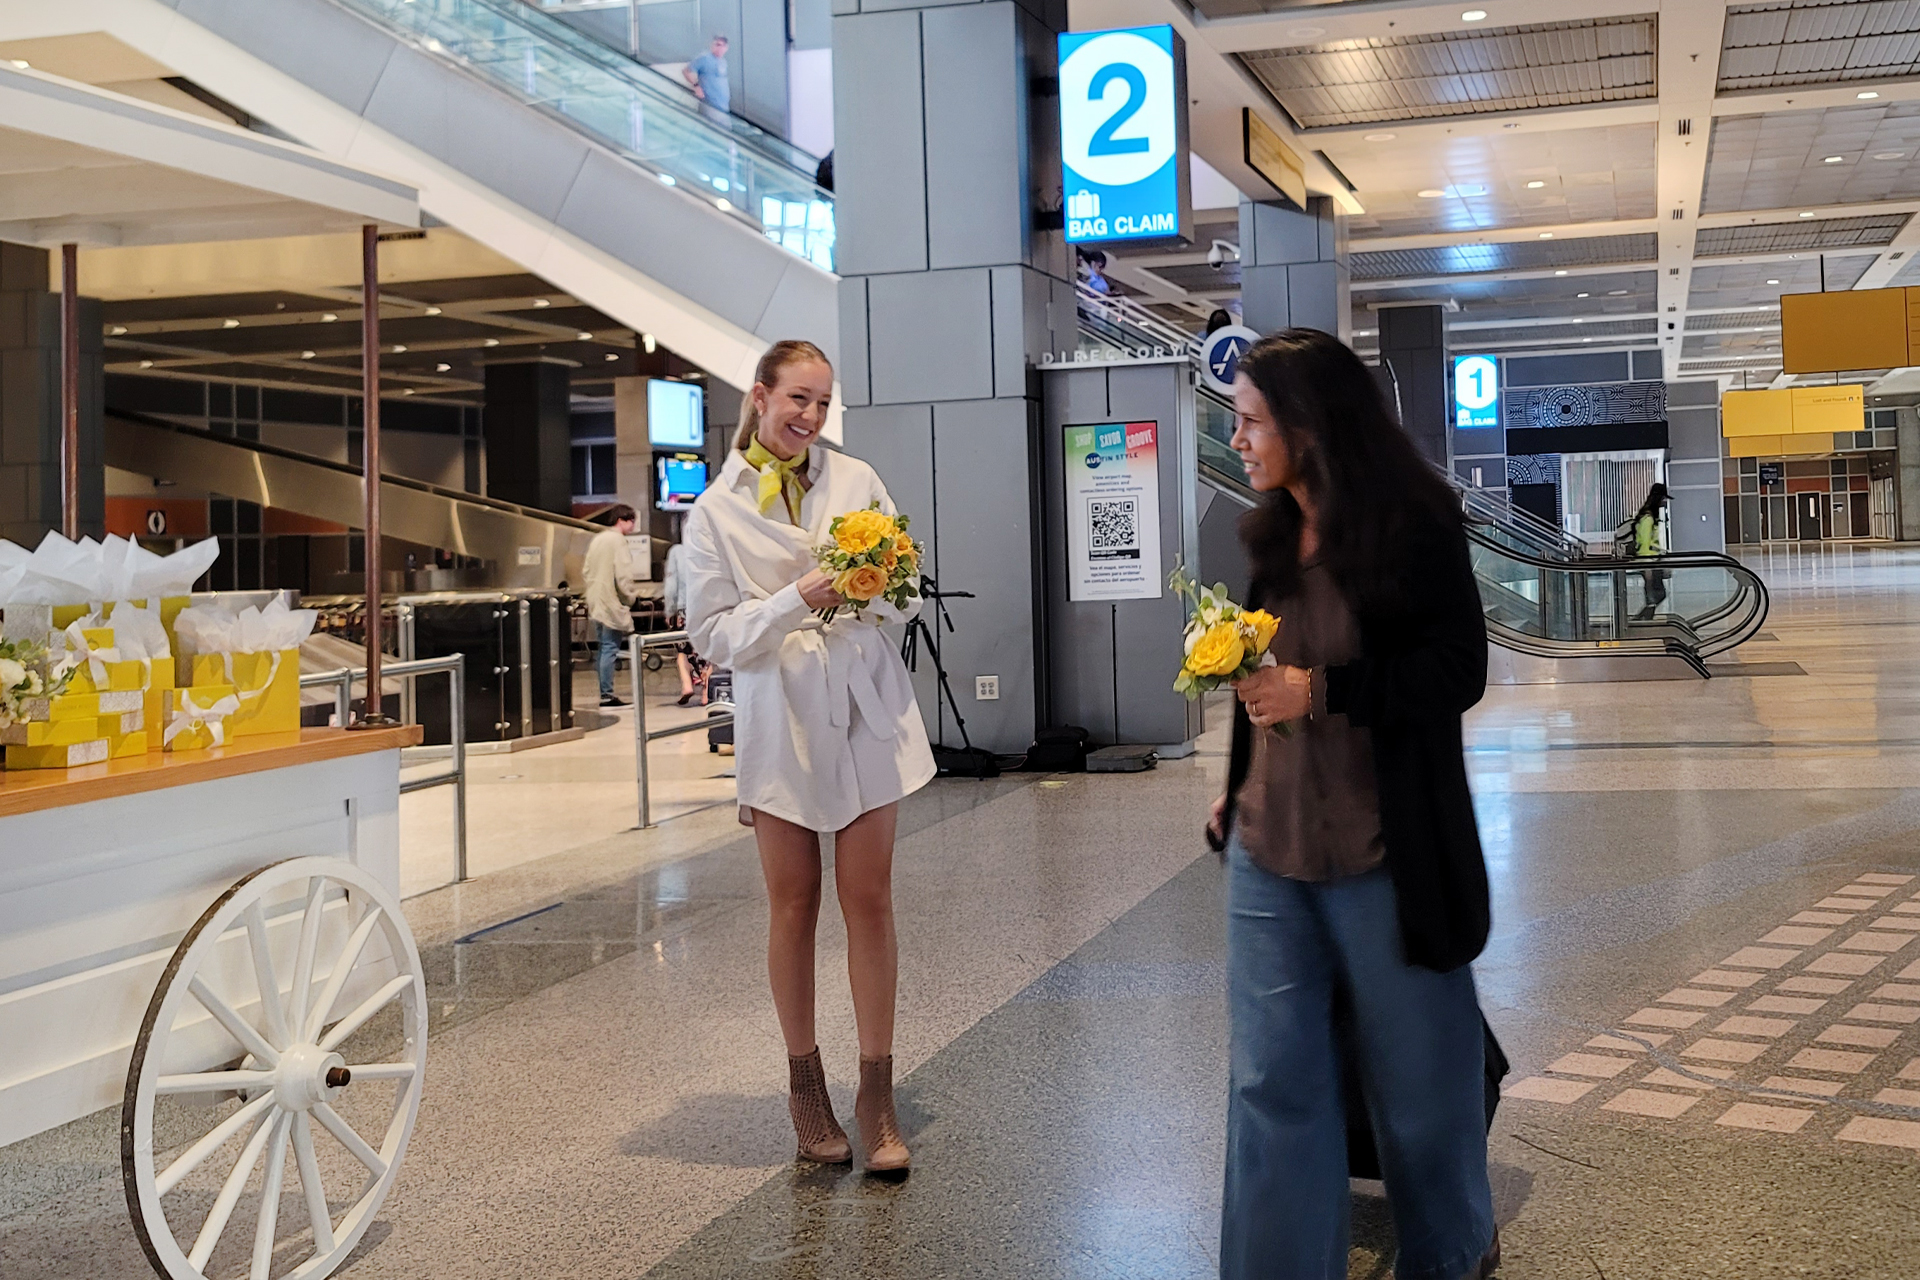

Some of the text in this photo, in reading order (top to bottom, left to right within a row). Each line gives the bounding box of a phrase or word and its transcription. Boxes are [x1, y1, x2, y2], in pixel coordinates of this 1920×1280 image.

[1087, 62, 1149, 157] 2
[1069, 212, 1175, 238] BAG CLAIM
[1042, 345, 1180, 364] DIRECTORY
[1469, 368, 1482, 398] 1
[1099, 430, 1122, 448] SAVOR
[1126, 428, 1154, 449] GROOVE
[1086, 452, 1139, 465] AUSTIN STYLE
